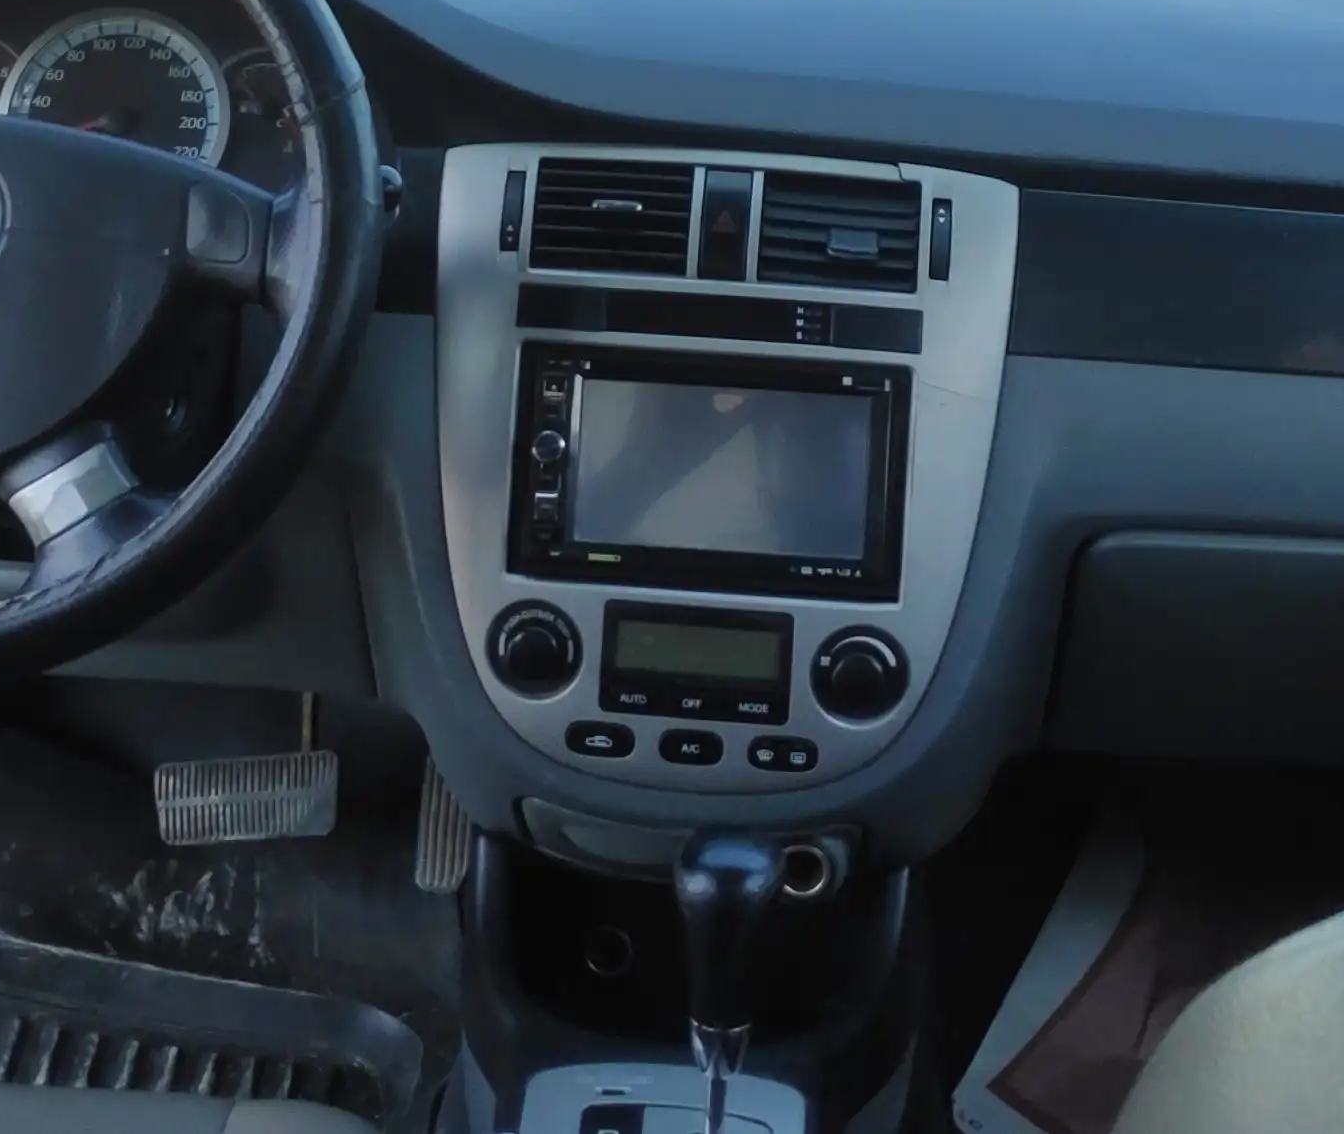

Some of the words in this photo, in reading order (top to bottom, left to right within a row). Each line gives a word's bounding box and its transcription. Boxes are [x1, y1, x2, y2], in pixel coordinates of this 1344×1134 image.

[93, 38, 116, 51] 100
[123, 37, 146, 49] 120
[67, 50, 86, 63] 80
[149, 48, 172, 61] 140
[45, 68, 64, 81] 60
[168, 65, 191, 79] 160
[32, 95, 51, 108] 40
[180, 90, 203, 103] 180
[178, 116, 206, 130] 200
[619, 693, 648, 705] AUTO
[681, 698, 703, 709] OFF
[738, 702, 770, 714] MODE
[681, 743, 700, 754] A/C
